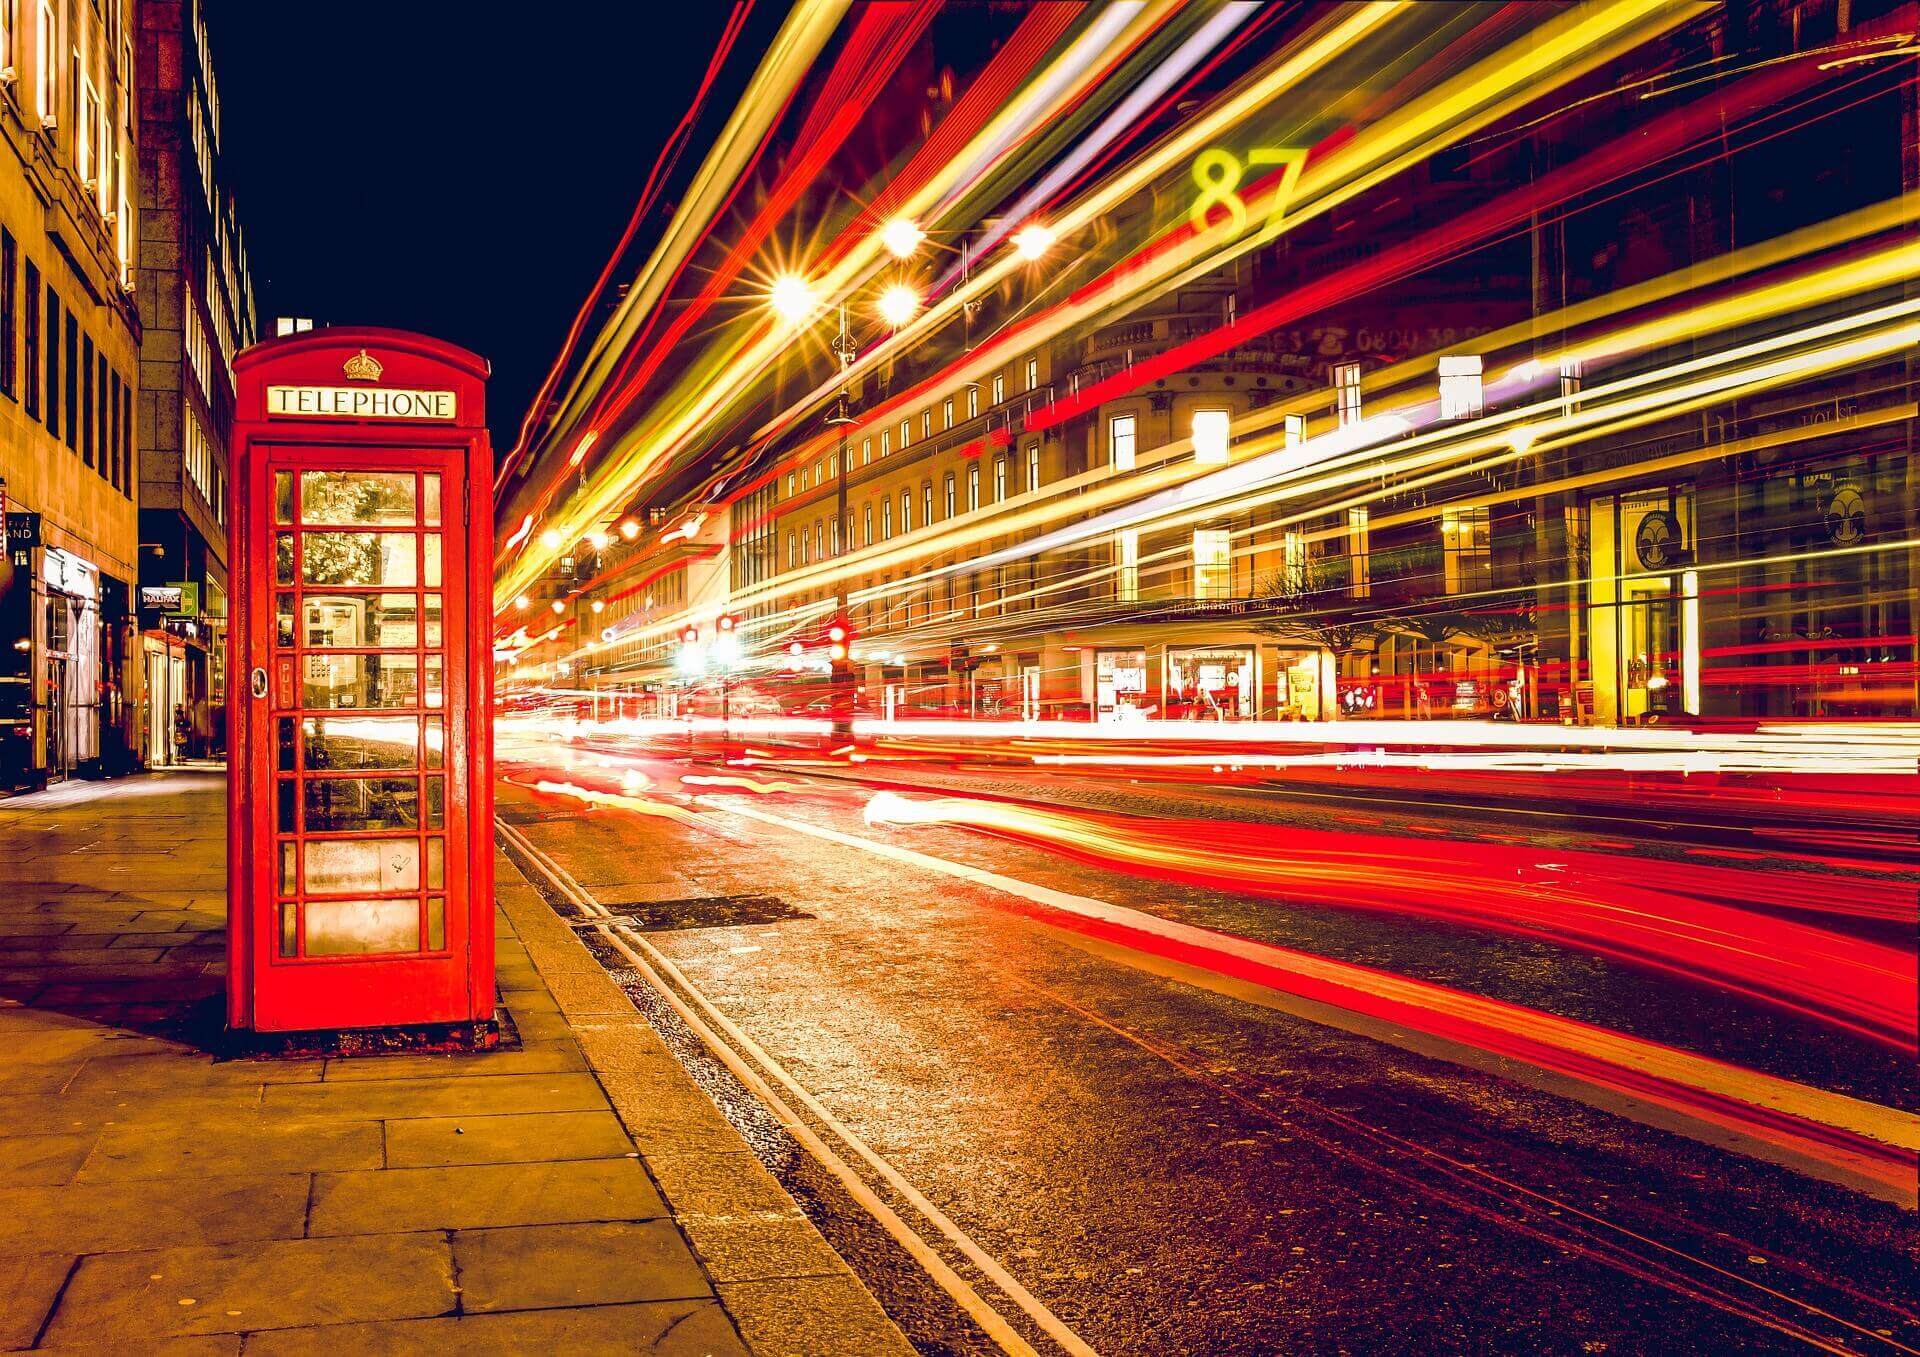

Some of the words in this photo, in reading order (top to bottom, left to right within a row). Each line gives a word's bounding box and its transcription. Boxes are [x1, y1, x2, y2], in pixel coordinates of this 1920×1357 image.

[1190, 147, 1310, 243] 87
[274, 389, 449, 417] TELEPHONE
[143, 594, 180, 603] HALIFAX
[282, 663, 290, 704] PULL
